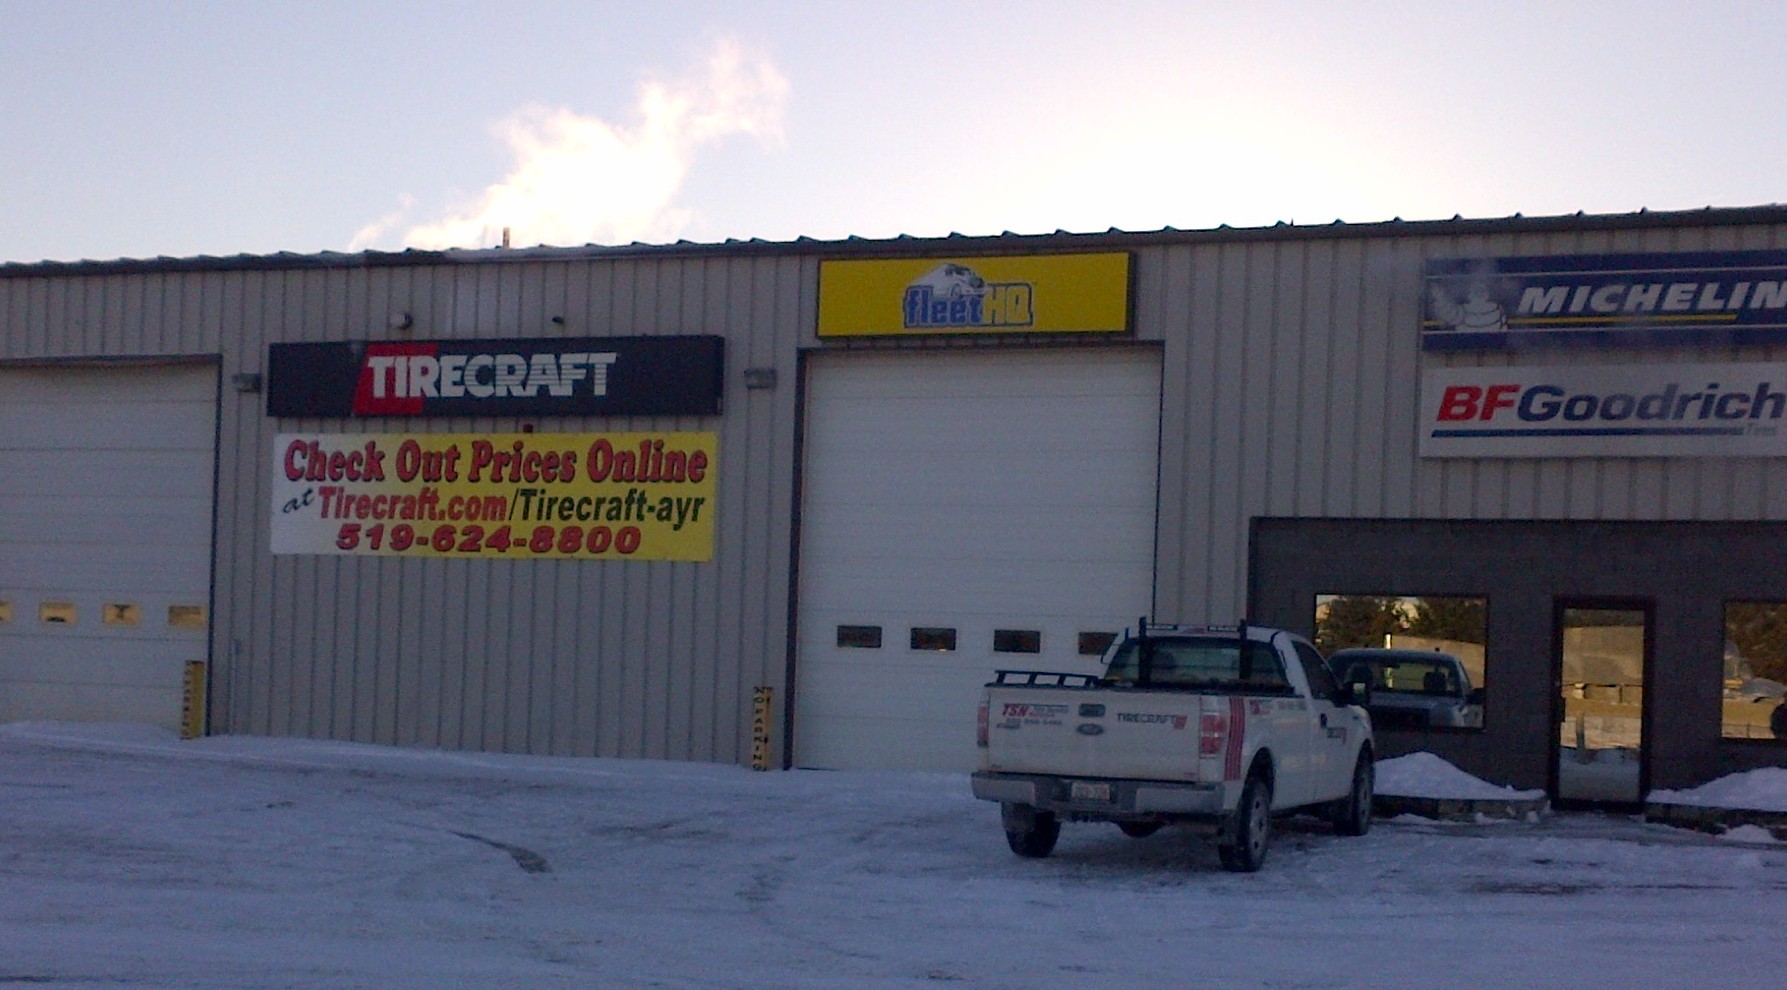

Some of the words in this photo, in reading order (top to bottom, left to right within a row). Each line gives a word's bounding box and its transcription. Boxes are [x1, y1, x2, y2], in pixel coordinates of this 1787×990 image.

[1518, 281, 1787, 313] MICHELIN
[367, 352, 617, 398] TIRECRAFT
[1437, 382, 1787, 422] BFGoodrich
[284, 440, 385, 482] Check
[395, 438, 459, 482] Out
[467, 440, 577, 483] Prices
[586, 438, 708, 483] Online
[282, 487, 316, 514] at
[336, 525, 642, 554] 519-624-8800
